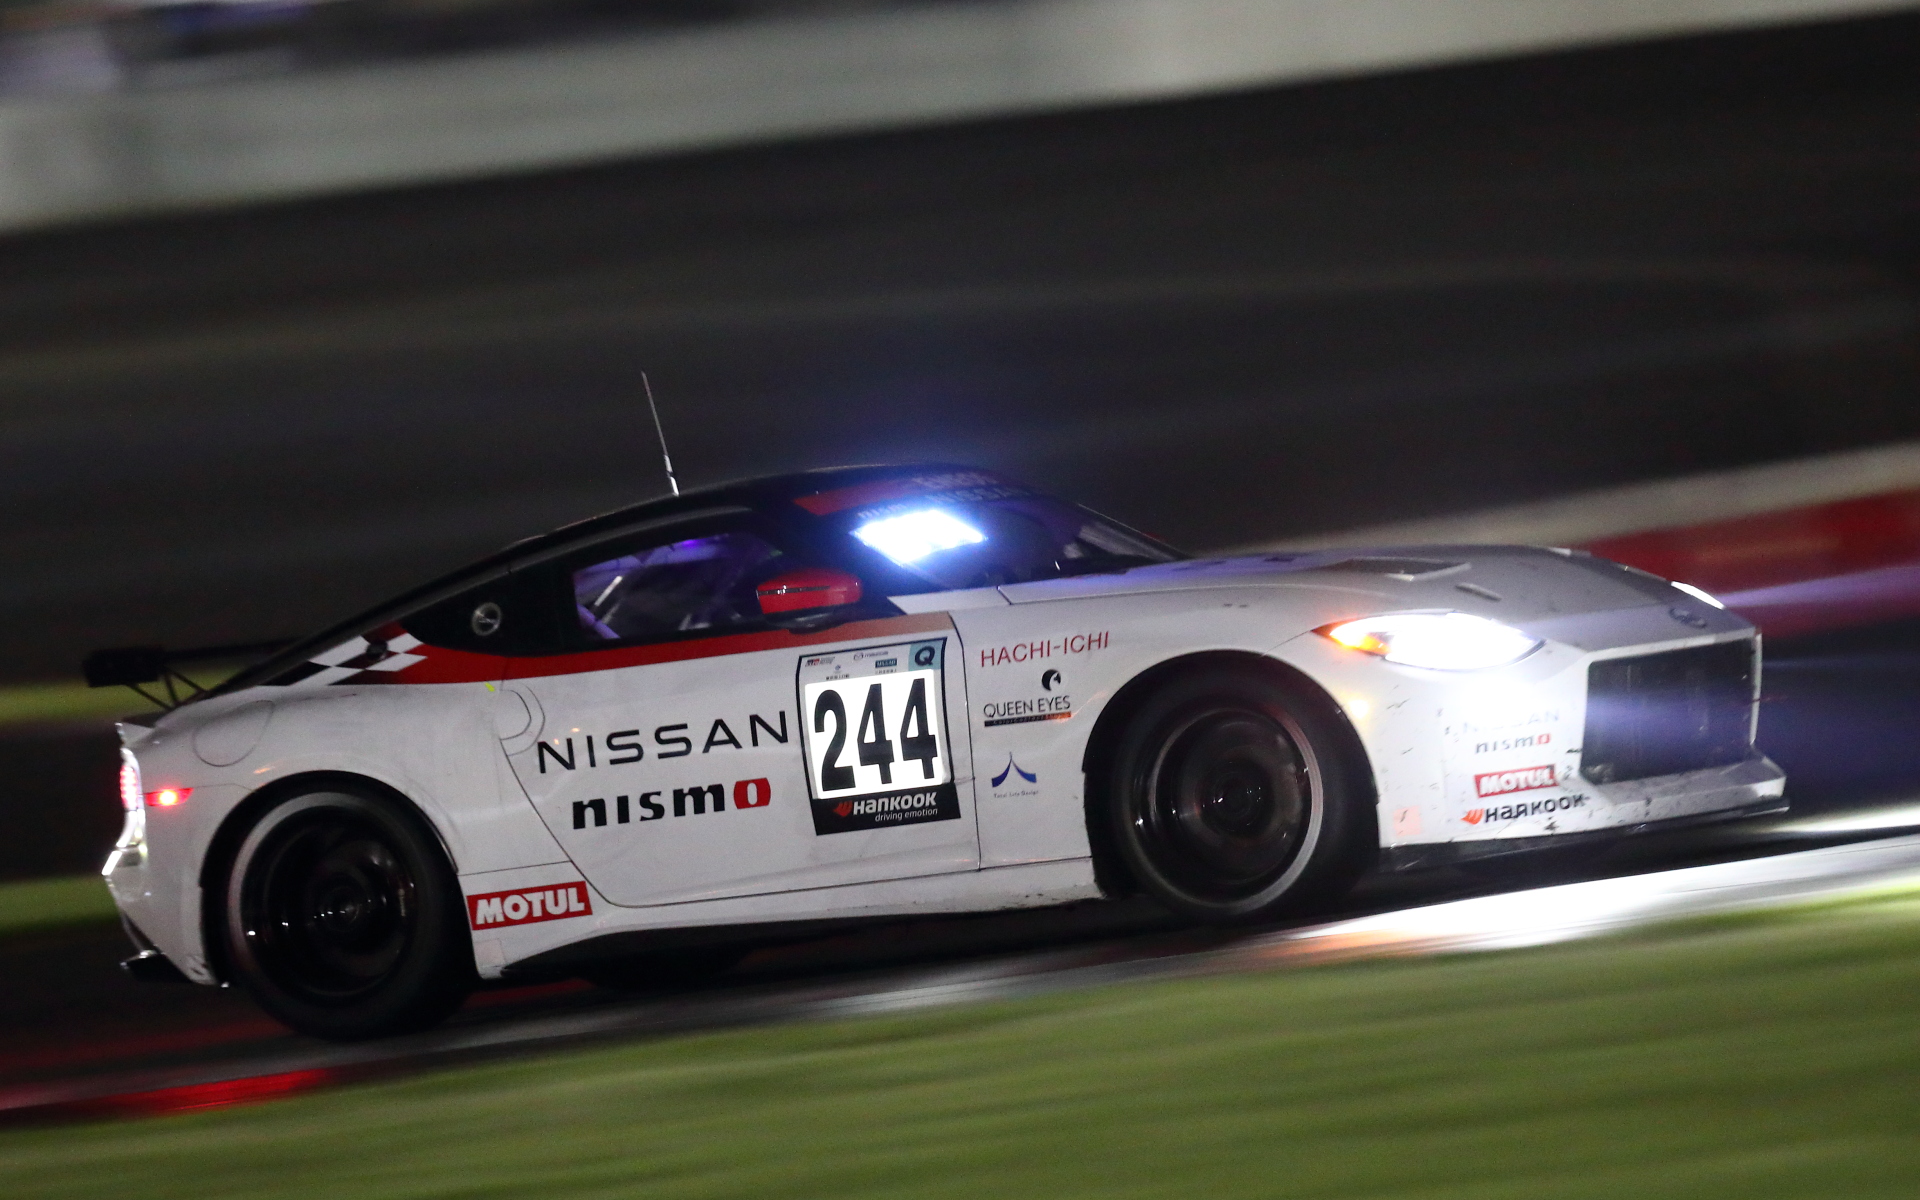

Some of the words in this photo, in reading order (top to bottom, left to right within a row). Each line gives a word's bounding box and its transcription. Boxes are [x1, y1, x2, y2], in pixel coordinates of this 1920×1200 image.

[914, 645, 936, 666] Q
[981, 631, 1109, 667] HACHI-ICHI
[983, 699, 1034, 718] QUEEN
[1038, 695, 1071, 712] EYES
[537, 710, 789, 774] NISSAN
[814, 678, 938, 792] 244
[1478, 768, 1554, 795] MOTUL
[572, 777, 771, 830] nismo
[874, 812, 903, 822] driving
[904, 808, 938, 818] emotion
[475, 887, 585, 925] MOTUL
